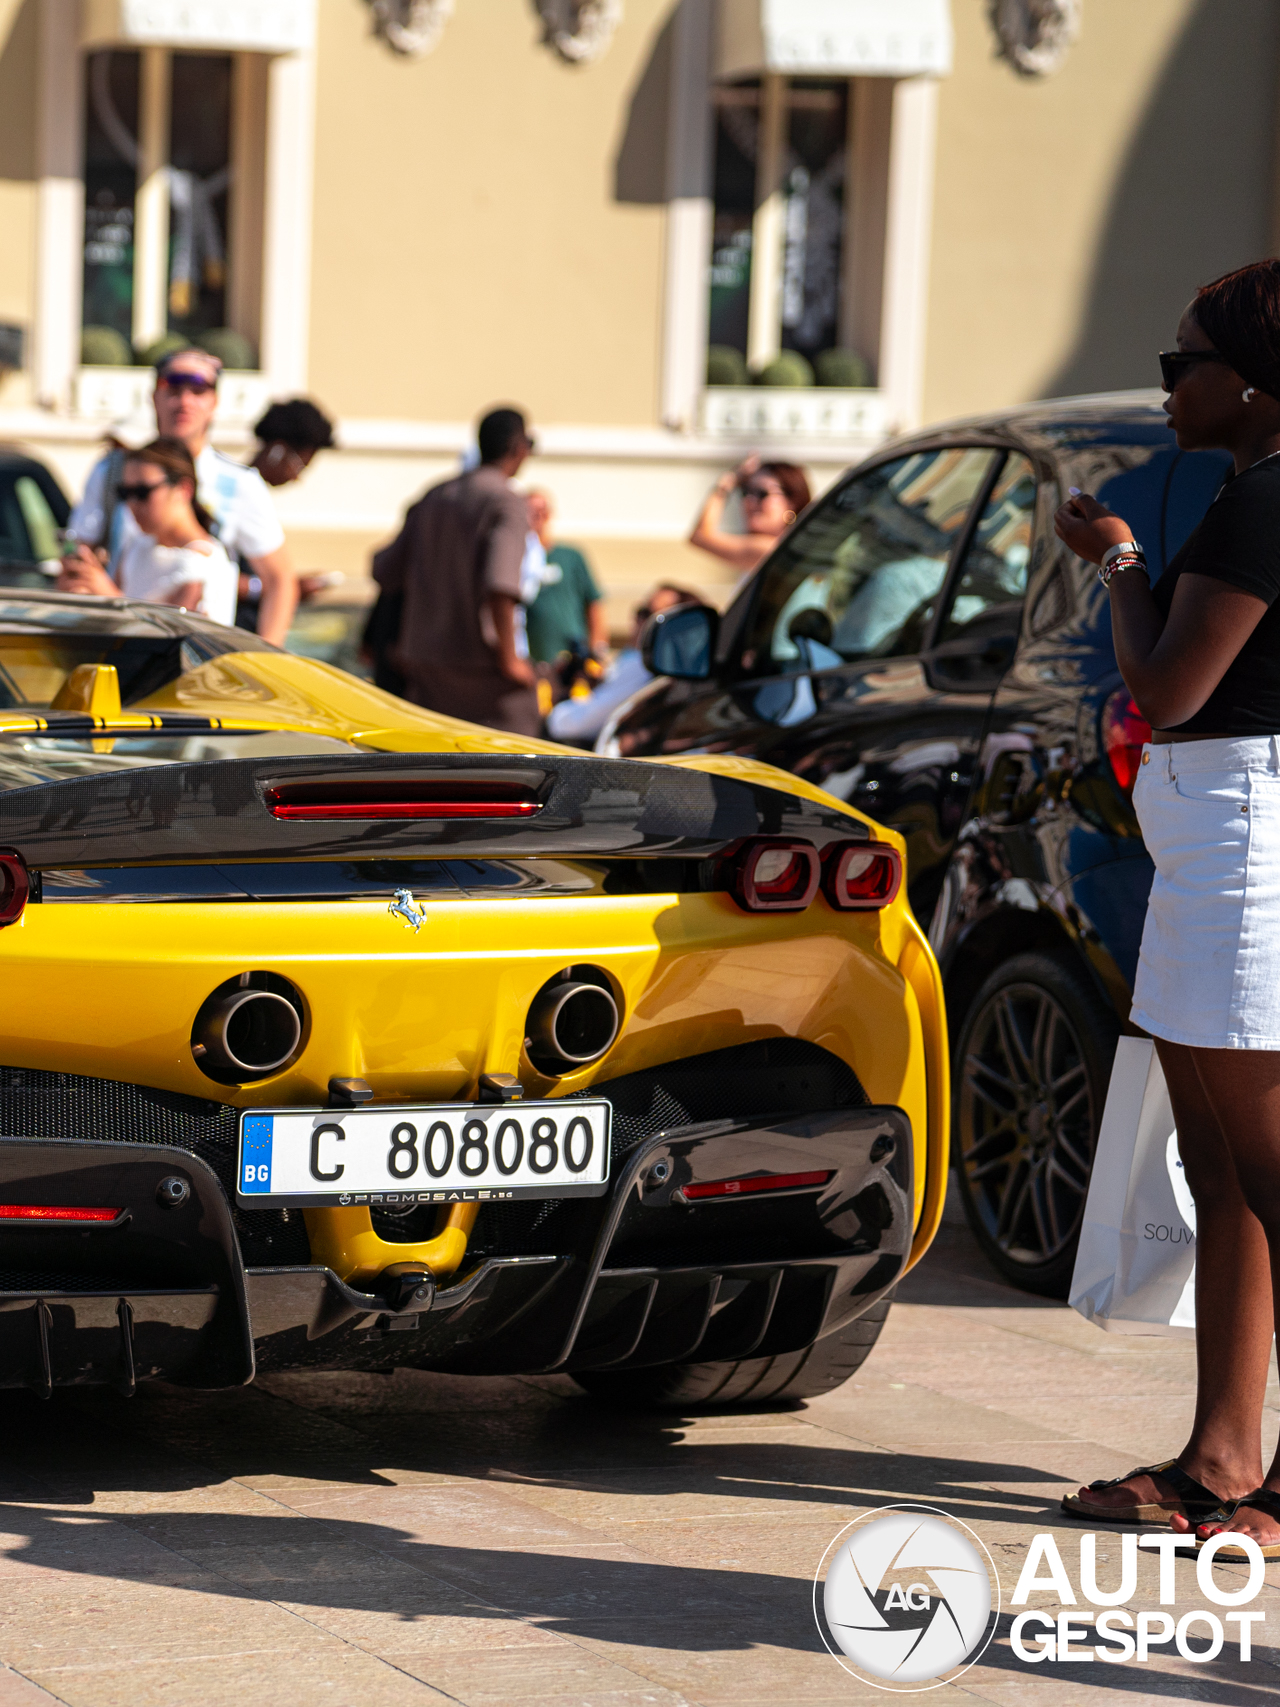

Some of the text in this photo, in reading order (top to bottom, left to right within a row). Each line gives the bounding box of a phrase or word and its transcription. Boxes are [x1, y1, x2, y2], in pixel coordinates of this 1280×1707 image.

[310, 1116, 594, 1181] C 808080
[244, 1164, 269, 1182] BG
